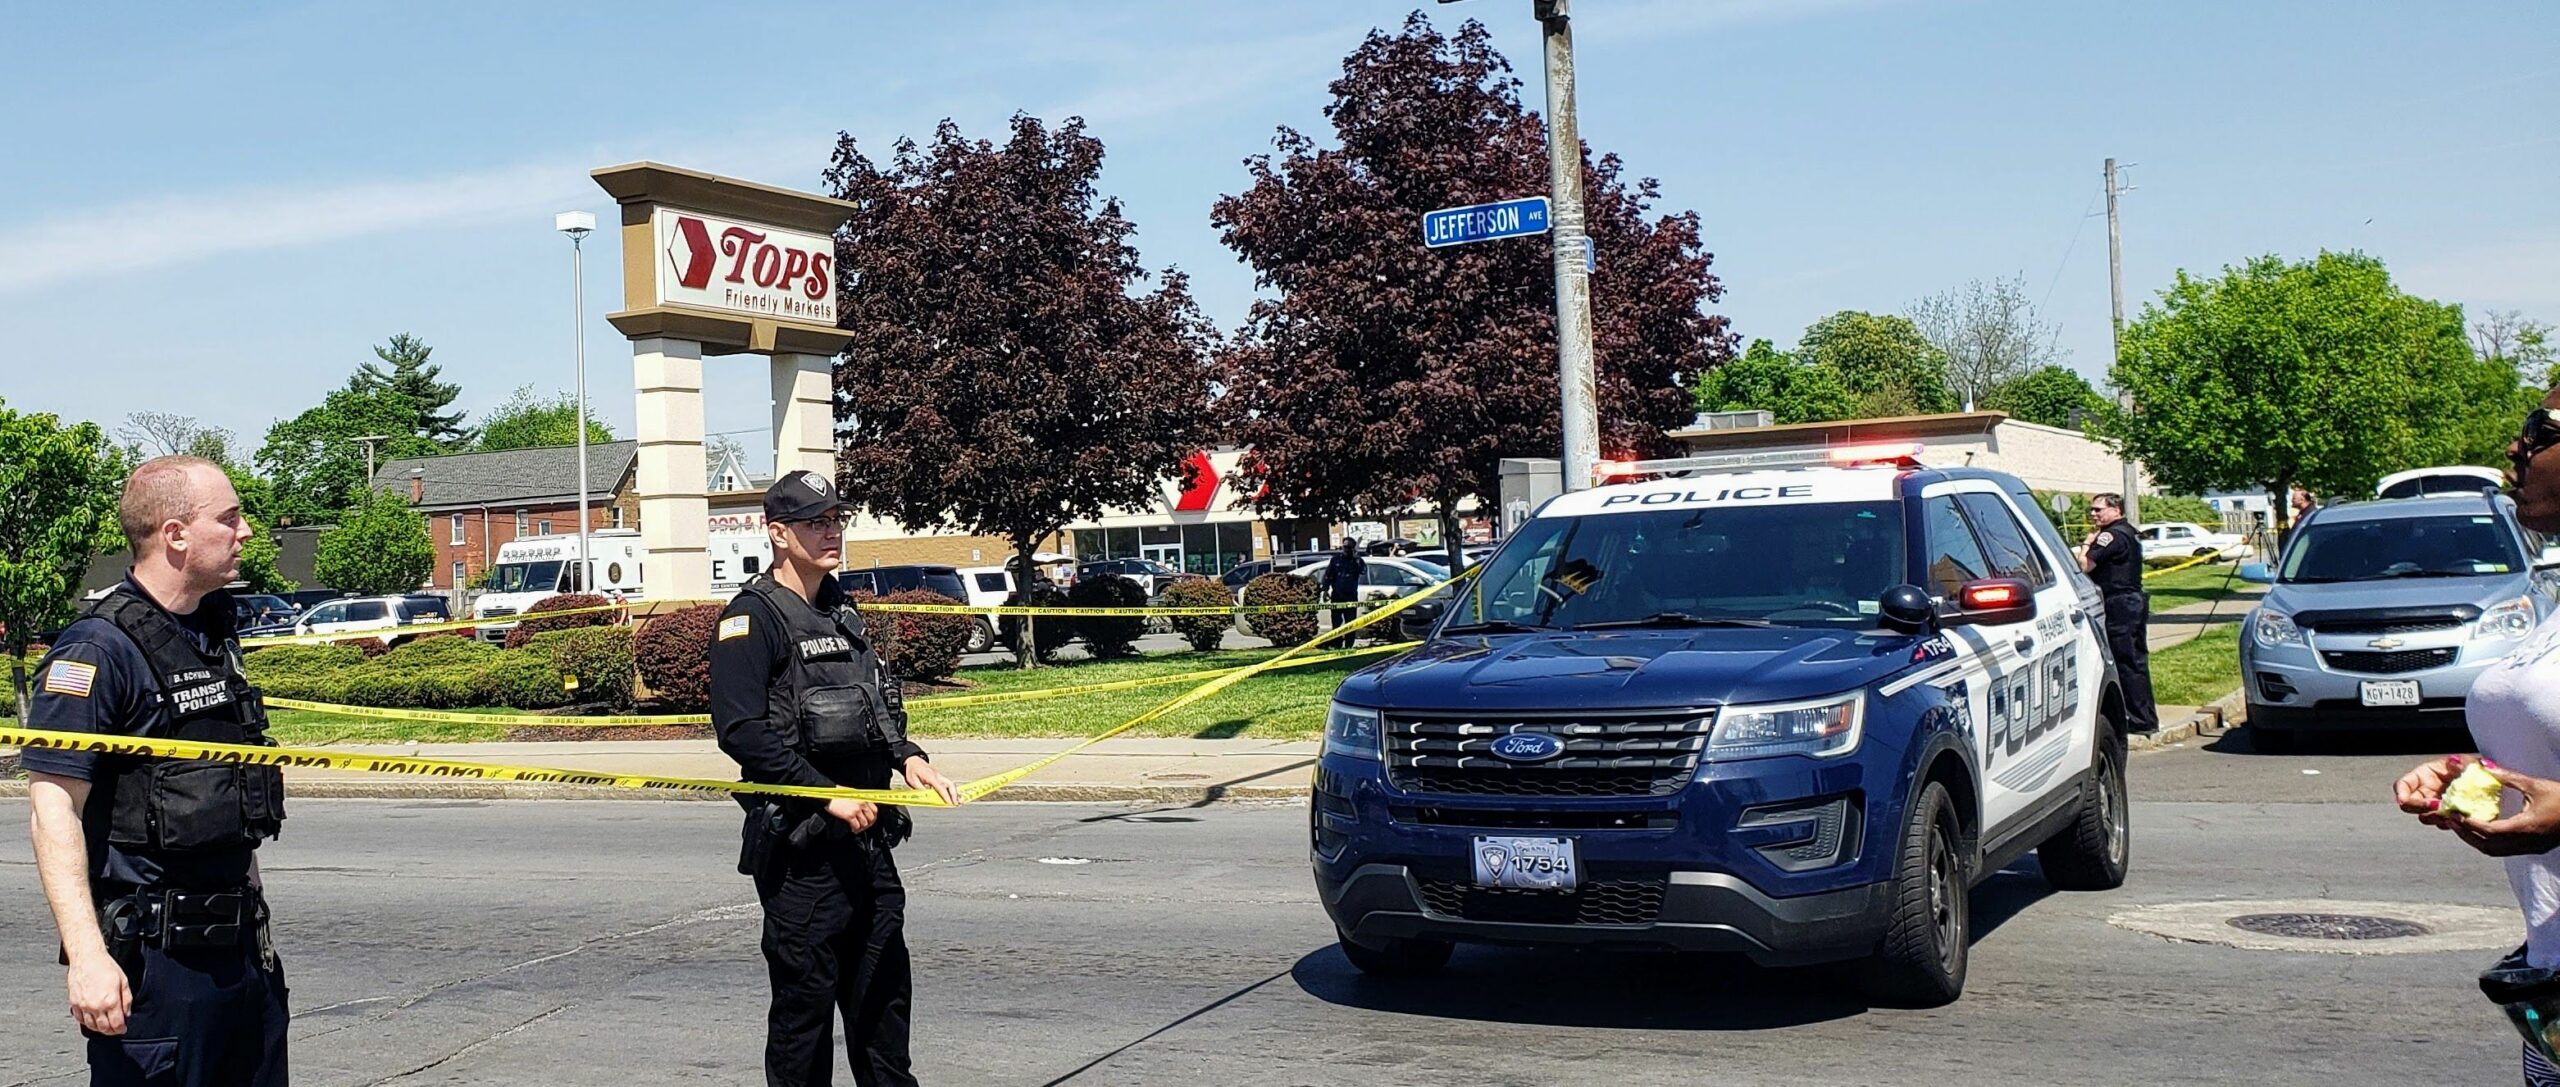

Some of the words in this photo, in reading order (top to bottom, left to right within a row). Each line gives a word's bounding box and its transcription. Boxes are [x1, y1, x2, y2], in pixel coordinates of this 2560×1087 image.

[1430, 206, 1520, 241] JEFFERSON
[1528, 211, 1543, 221] AVE
[725, 288, 778, 312] Friendly
[784, 296, 832, 318] Markets
[1600, 485, 1813, 507] POLICE
[708, 516, 739, 532] OOD
[800, 637, 838, 659] POLICE
[1922, 636, 1953, 656] 1754
[171, 680, 226, 704] TRANSIT
[179, 692, 228, 714] POLICE
[1985, 638, 2078, 770] POLICE
[1505, 737, 1545, 753] Ford
[1511, 856, 1570, 874] 1754
